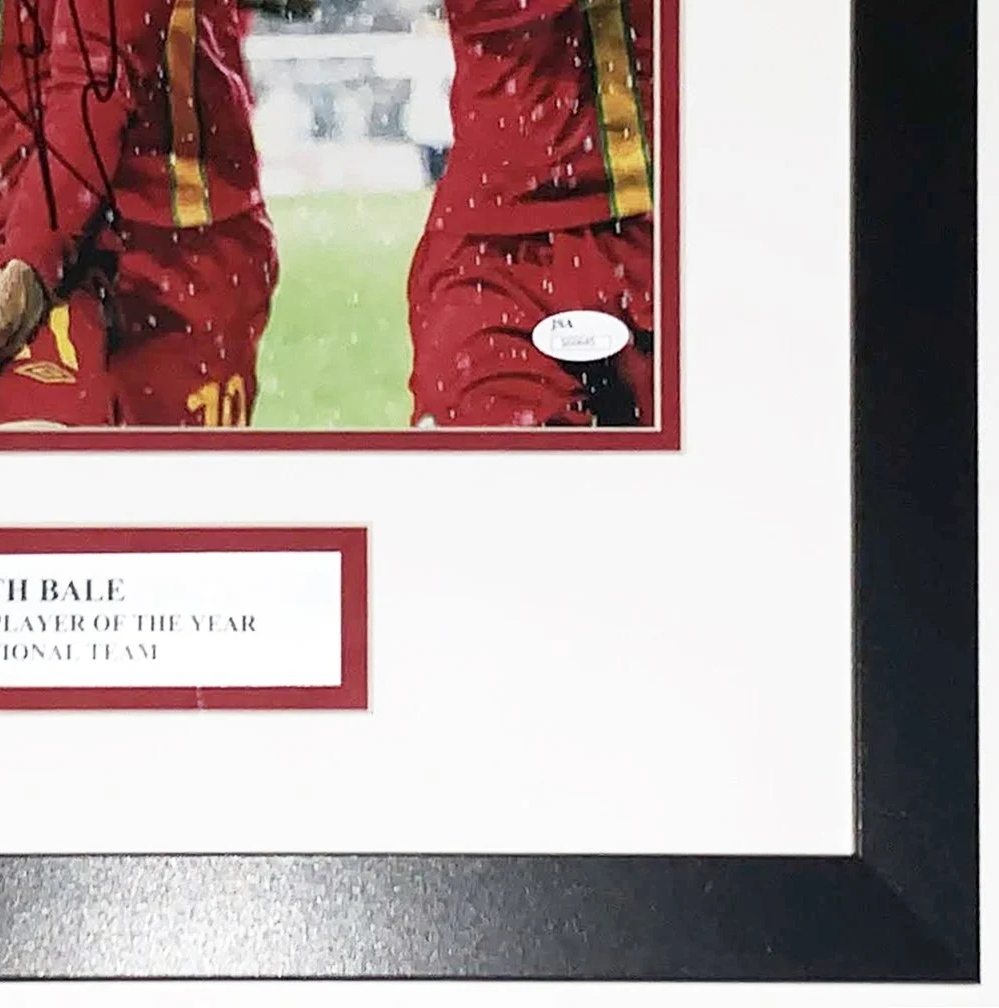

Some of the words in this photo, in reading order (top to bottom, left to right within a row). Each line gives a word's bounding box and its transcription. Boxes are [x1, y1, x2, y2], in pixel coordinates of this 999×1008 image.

[40, 577, 125, 602] BALE
[93, 614, 126, 632] OF
[133, 613, 182, 632] THE
[191, 613, 256, 632] YEAR
[88, 642, 157, 660] TEAM
